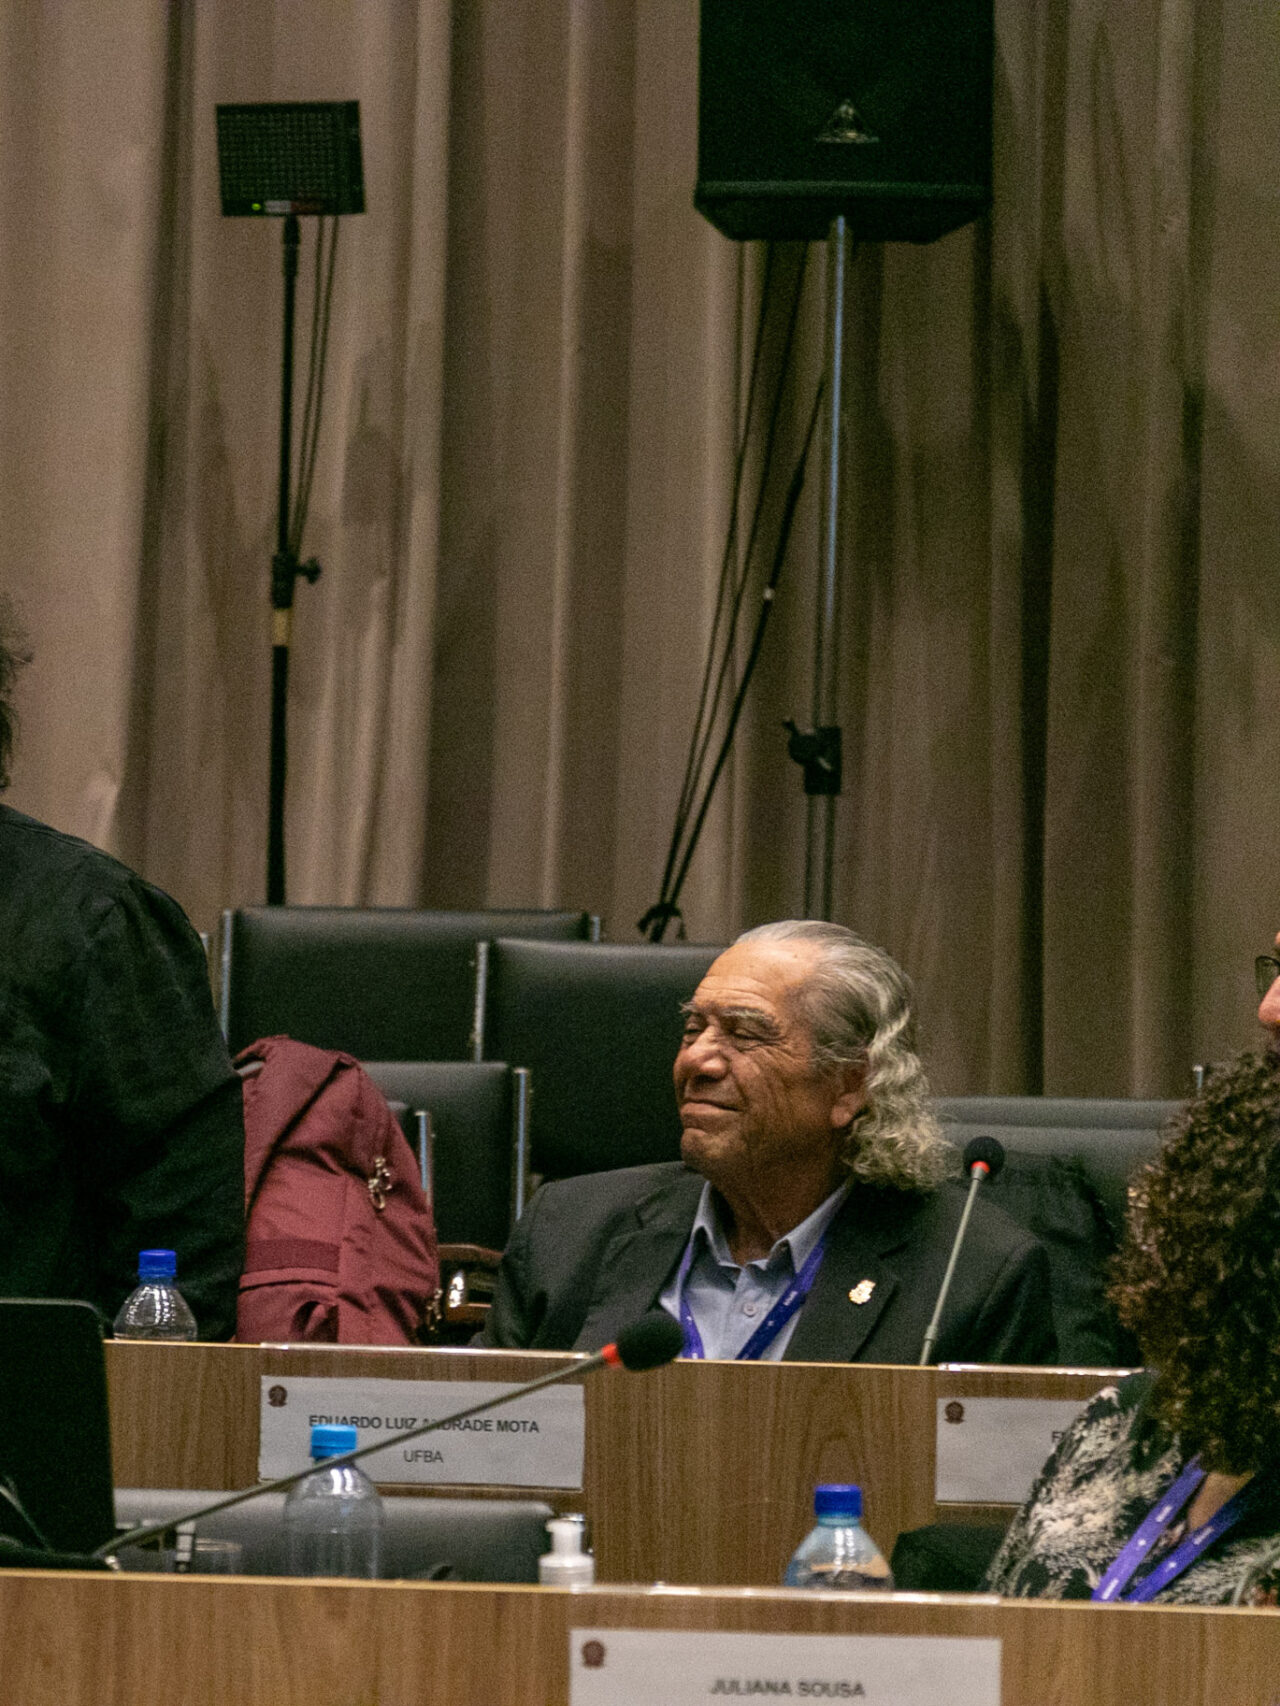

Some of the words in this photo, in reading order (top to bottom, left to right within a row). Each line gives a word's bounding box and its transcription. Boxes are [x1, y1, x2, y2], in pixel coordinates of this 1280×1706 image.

[386, 1417, 417, 1430] LUIZ
[497, 1420, 539, 1433] MOTA
[403, 1450, 444, 1463] UFBA
[711, 1679, 792, 1696] JULIANA
[798, 1680, 866, 1698] SOUSA
